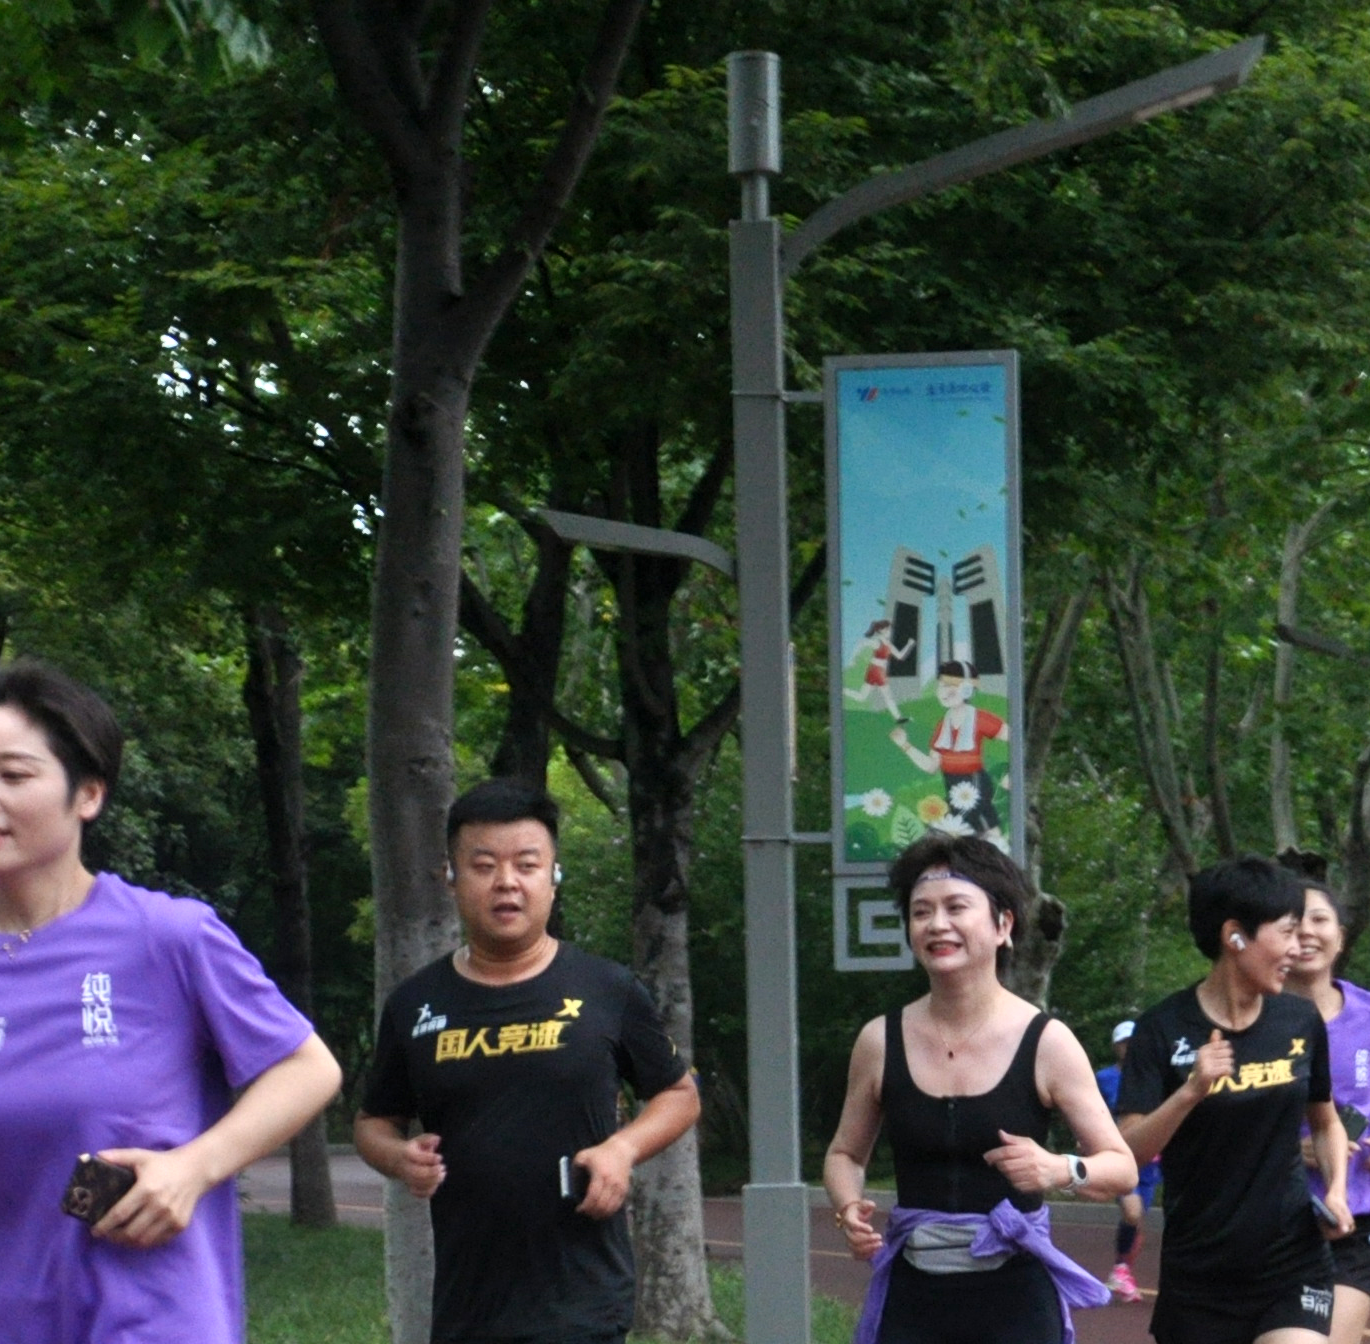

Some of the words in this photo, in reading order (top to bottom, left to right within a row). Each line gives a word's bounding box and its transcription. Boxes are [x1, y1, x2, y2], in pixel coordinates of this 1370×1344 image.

[81, 973, 113, 1035] 纯悦
[436, 1020, 566, 1063] 国人竞速
[1189, 1058, 1296, 1094] 人竞速
